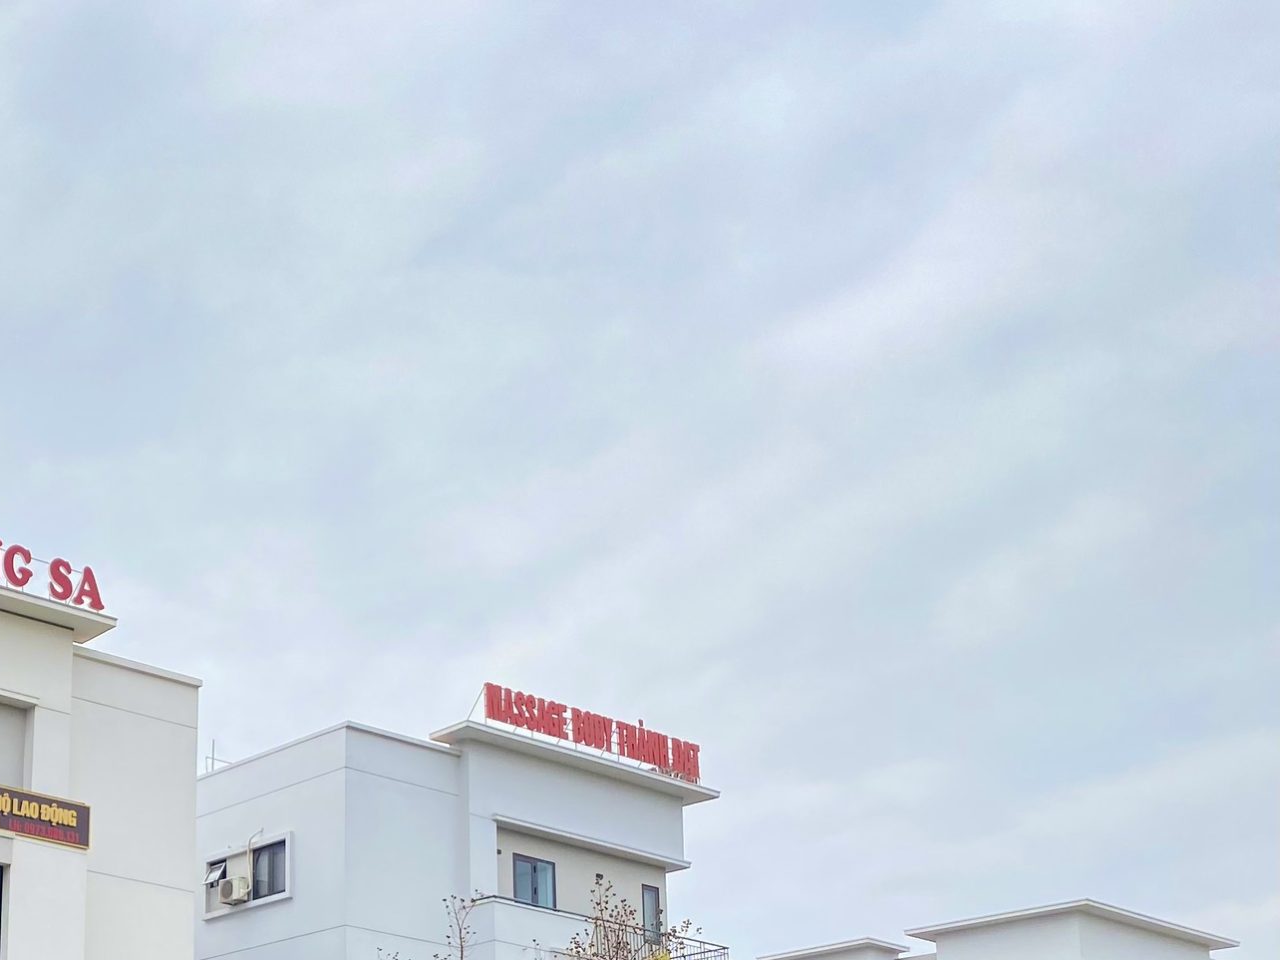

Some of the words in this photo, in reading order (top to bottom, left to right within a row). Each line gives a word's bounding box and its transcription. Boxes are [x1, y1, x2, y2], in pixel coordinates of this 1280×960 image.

[48, 557, 105, 611] SA
[485, 682, 568, 741] MASSAGE
[571, 707, 613, 753] BODY
[13, 800, 40, 819] LAO
[40, 803, 78, 827] ĐỘNG
